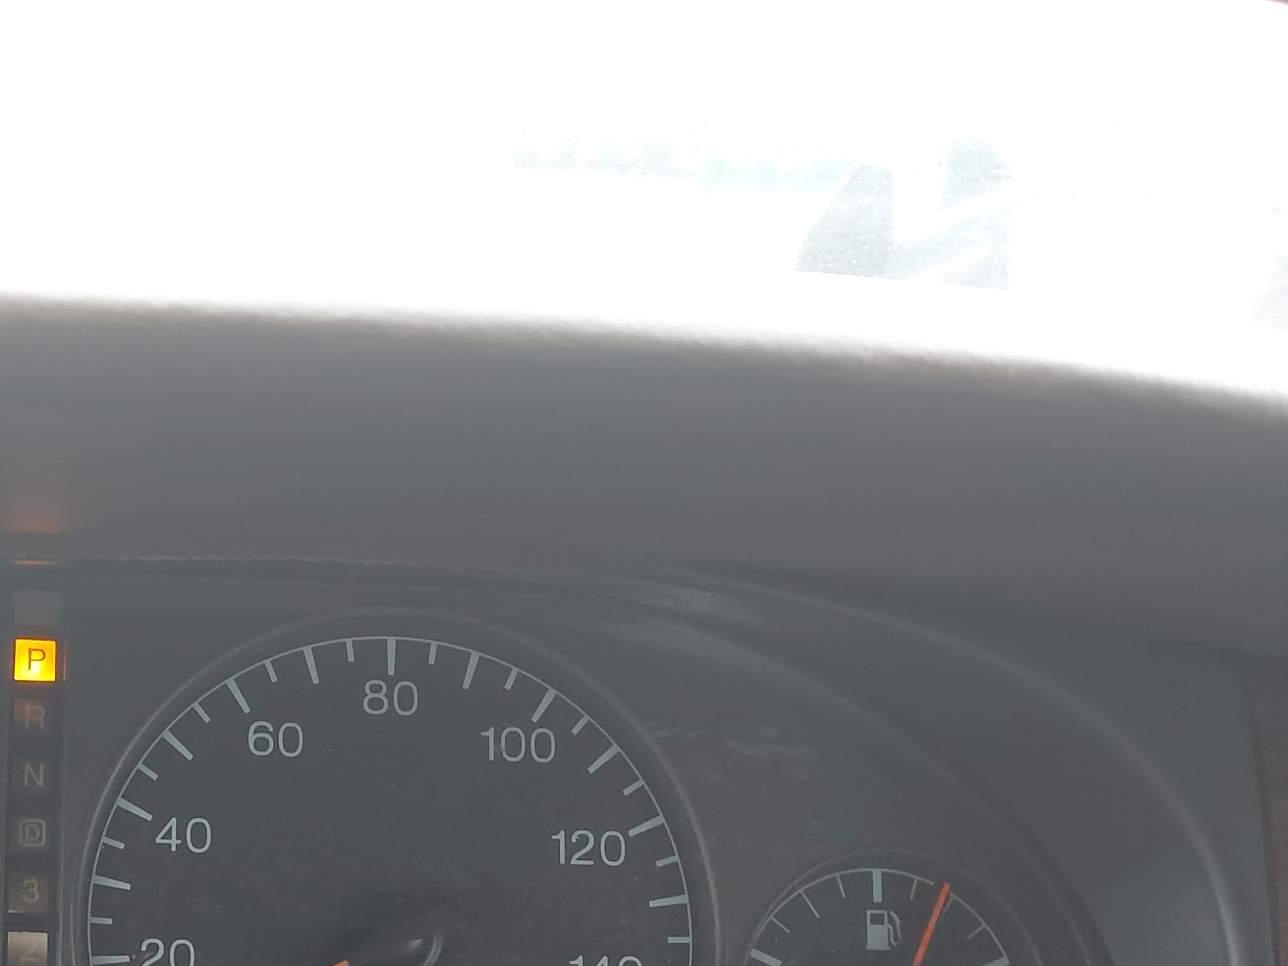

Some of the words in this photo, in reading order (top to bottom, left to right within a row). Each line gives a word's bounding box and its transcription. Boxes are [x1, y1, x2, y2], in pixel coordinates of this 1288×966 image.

[27, 648, 47, 670] P
[363, 681, 418, 715] 80
[24, 705, 46, 729] R
[247, 721, 304, 757] 60
[480, 727, 556, 763] 100
[23, 762, 45, 787] N
[154, 818, 212, 852] 40
[551, 830, 626, 866] 120
[22, 878, 40, 903] 3
